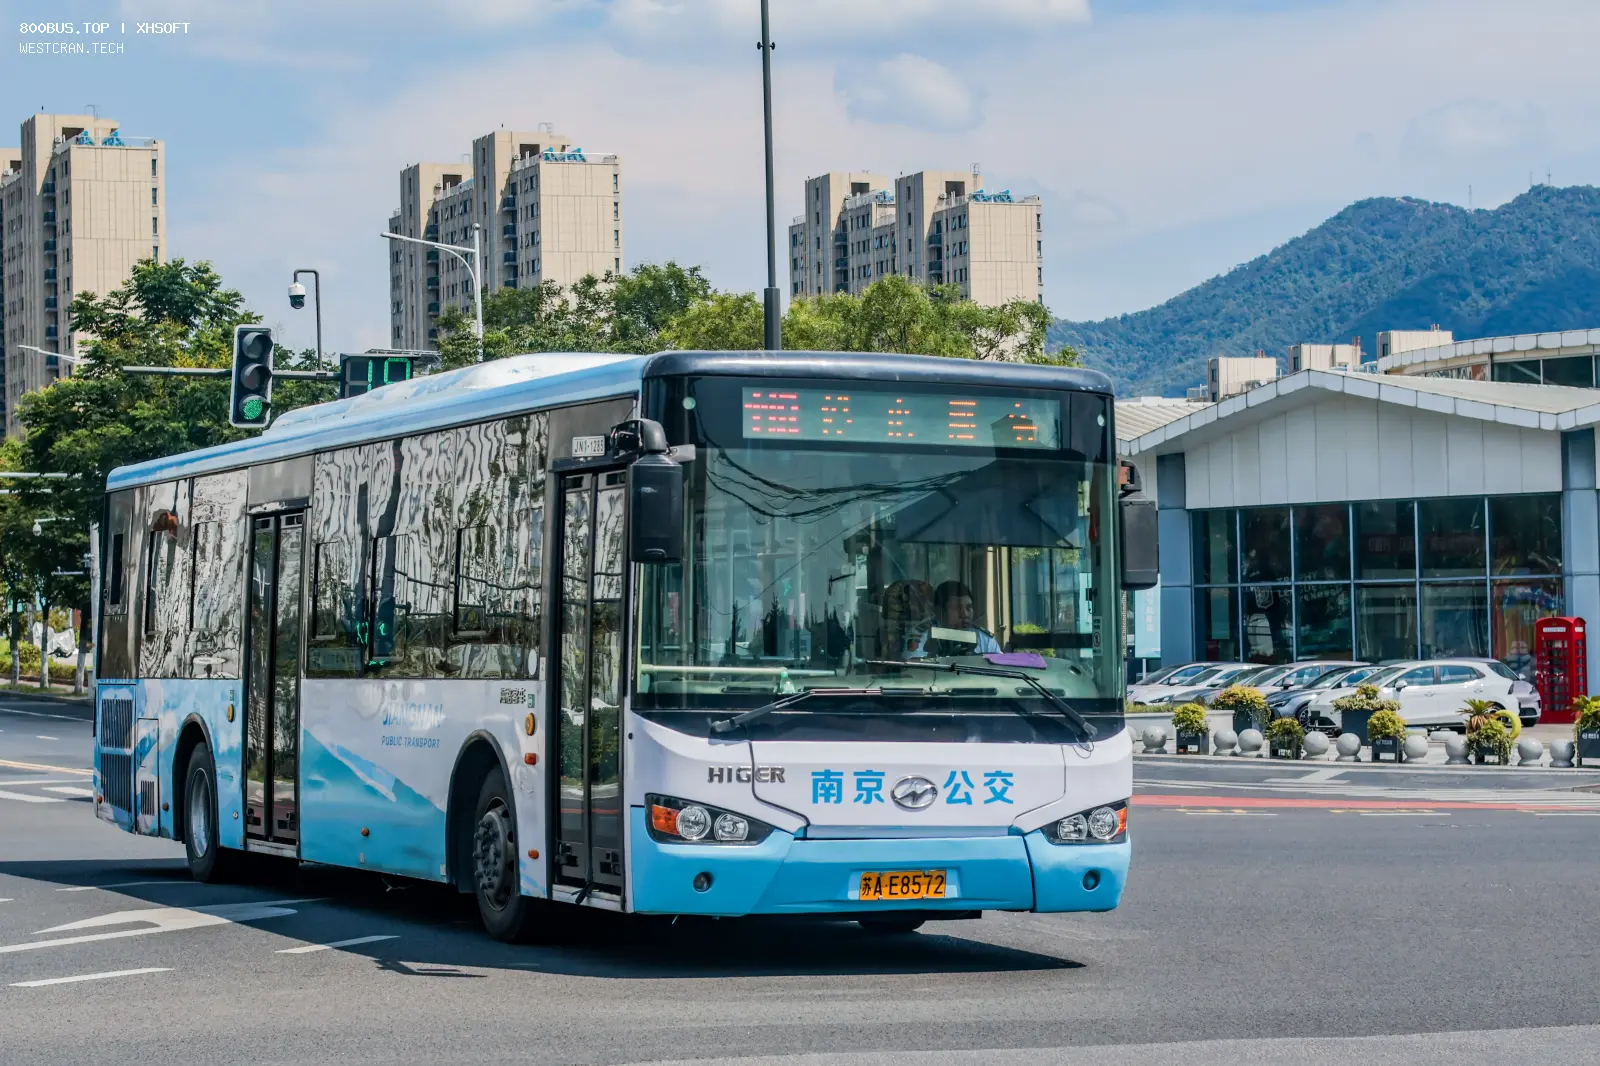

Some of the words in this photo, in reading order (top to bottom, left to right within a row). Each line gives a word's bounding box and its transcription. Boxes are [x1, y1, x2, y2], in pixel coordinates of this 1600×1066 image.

[382, 736, 403, 746] PUBLIC
[404, 736, 440, 748] TRANSPORT
[708, 767, 785, 784] HIGER
[811, 769, 886, 805] 南京
[943, 770, 1014, 805] 公交
